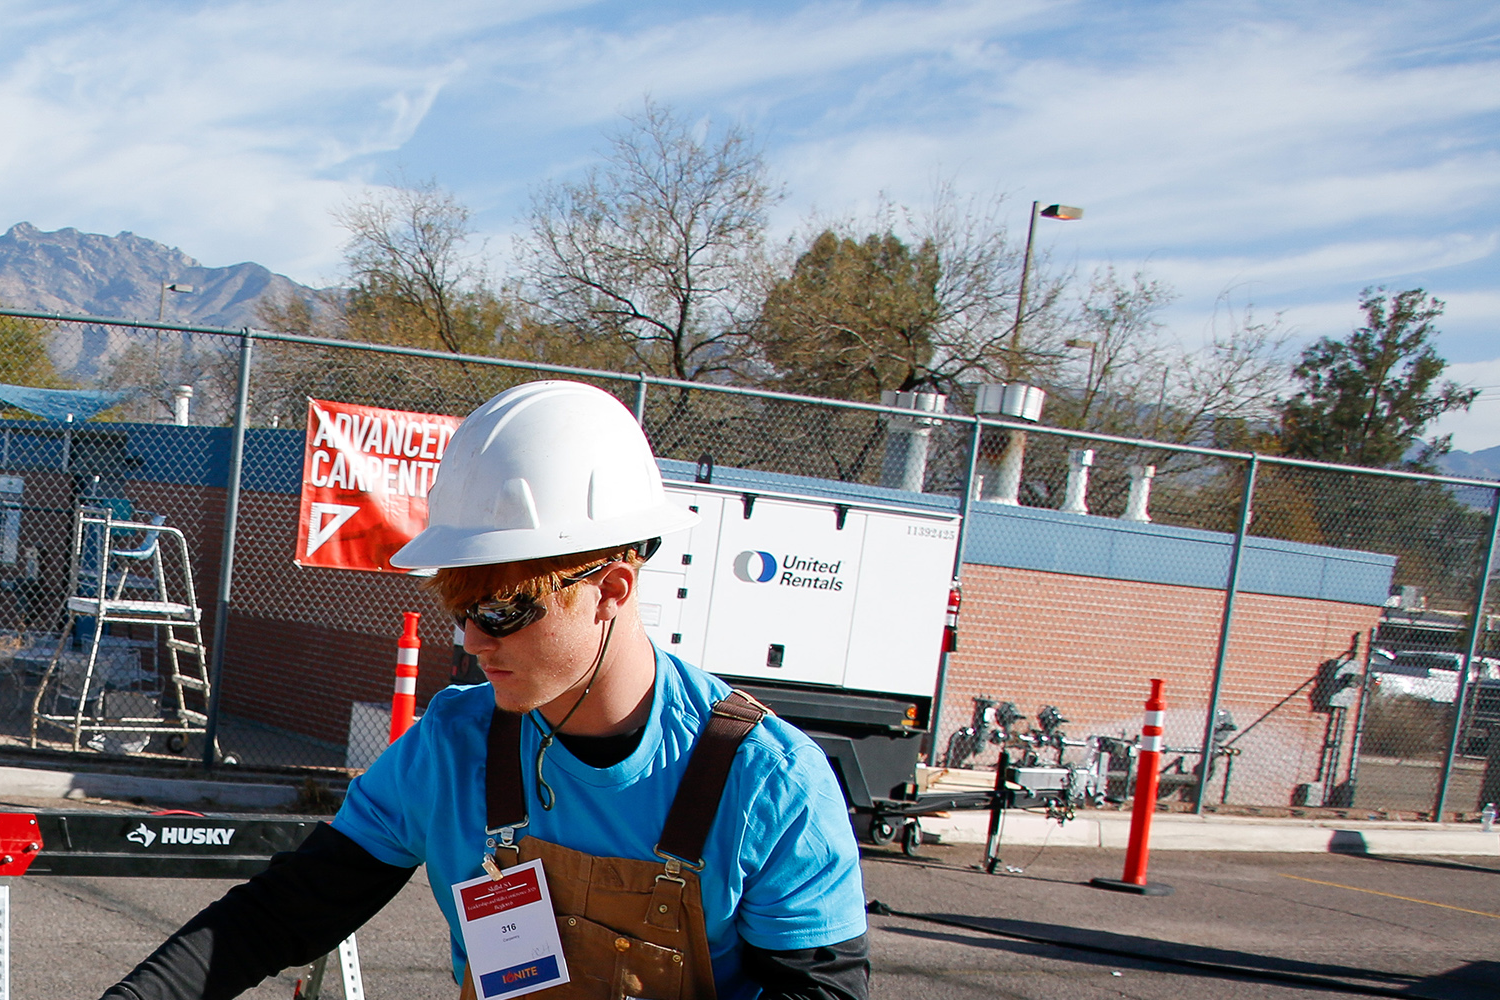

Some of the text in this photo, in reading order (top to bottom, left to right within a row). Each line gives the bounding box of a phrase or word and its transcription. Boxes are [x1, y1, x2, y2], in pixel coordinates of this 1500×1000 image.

[782, 554, 841, 574] United
[779, 571, 843, 592] Rentals
[161, 827, 236, 846] HUSKY
[501, 922, 517, 934] 316
